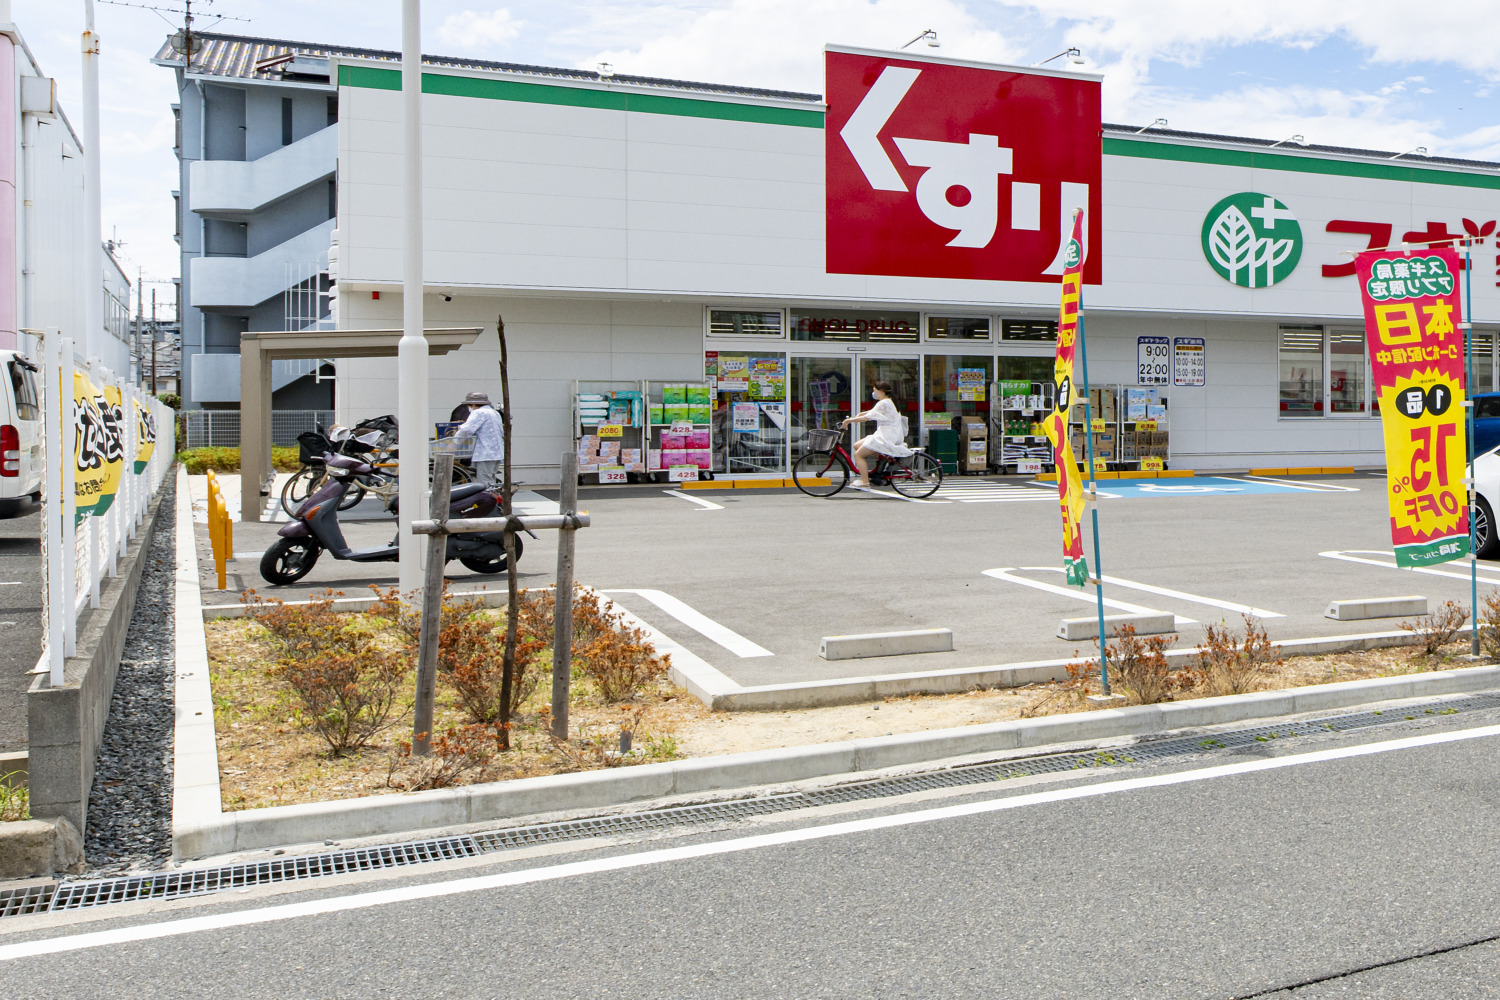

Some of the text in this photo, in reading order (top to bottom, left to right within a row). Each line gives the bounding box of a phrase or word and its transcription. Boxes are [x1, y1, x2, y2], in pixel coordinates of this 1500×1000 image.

[839, 65, 1090, 276] くすり
[855, 319, 910, 334] DRUG
[1145, 345, 1168, 357] 9:00
[1139, 363, 1168, 375] 22:00
